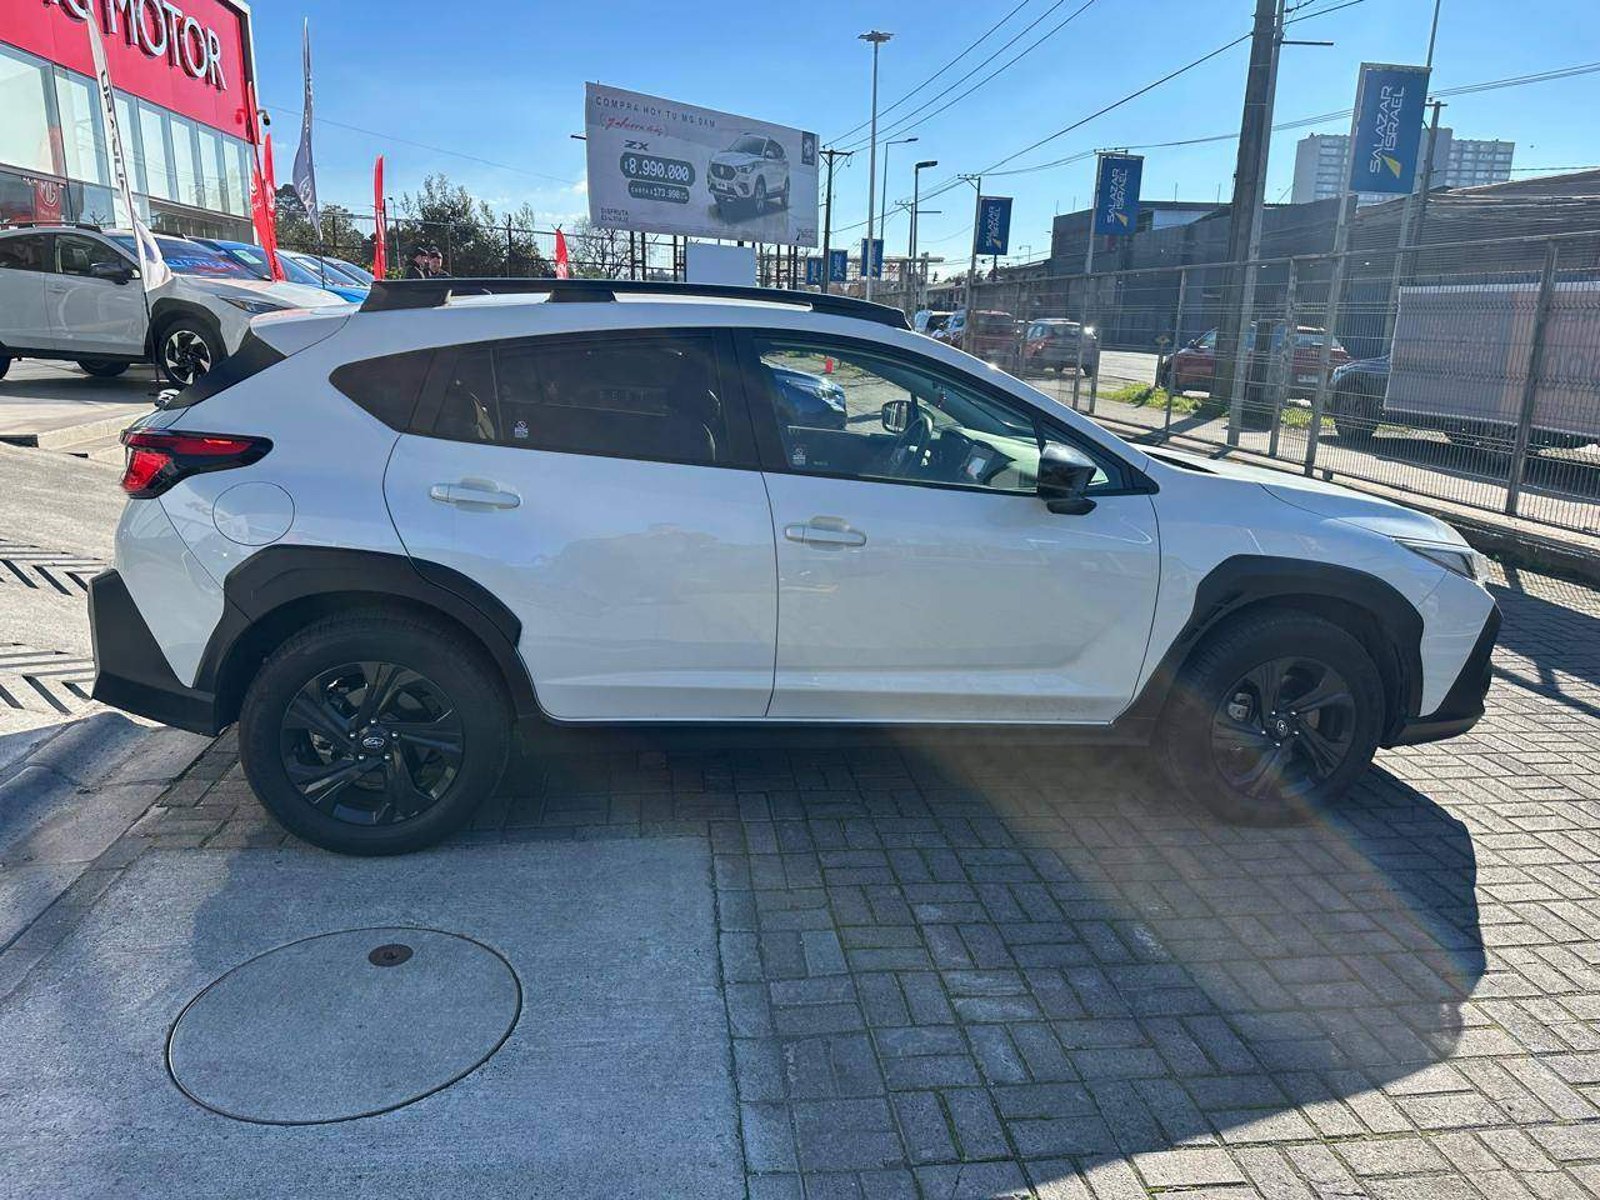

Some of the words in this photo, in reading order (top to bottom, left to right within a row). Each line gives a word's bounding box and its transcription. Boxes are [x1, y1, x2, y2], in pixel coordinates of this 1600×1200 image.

[103, 0, 228, 91] MOTOR
[595, 96, 639, 112] COMPRA
[643, 104, 662, 117] HOY
[665, 110, 678, 121] TU
[1369, 85, 1393, 174] SALAZAR
[1384, 86, 1405, 152] ISRAEL
[624, 139, 649, 152] ZX
[1106, 168, 1120, 224] SALAZAR
[1116, 169, 1128, 210] ISRAEL
